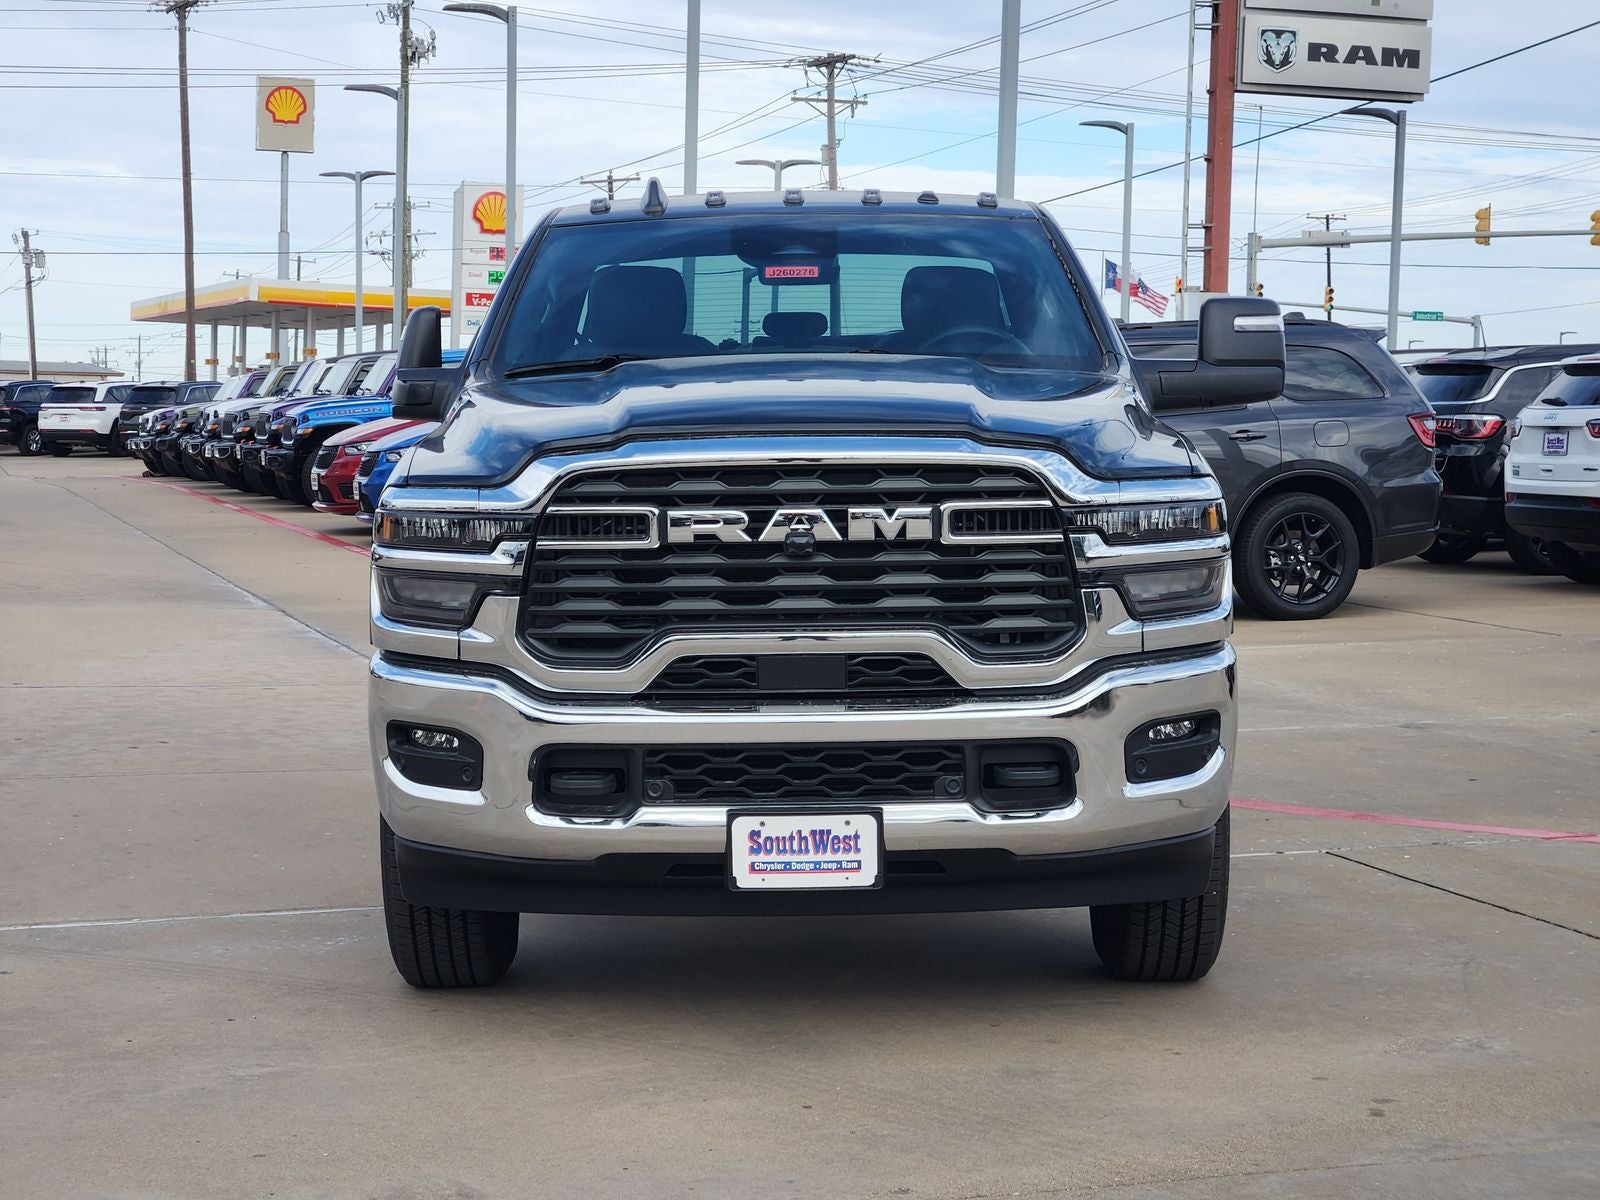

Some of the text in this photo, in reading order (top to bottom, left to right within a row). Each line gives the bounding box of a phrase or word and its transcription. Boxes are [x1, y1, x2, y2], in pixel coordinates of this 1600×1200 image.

[1307, 42, 1420, 69] RAM
[769, 268, 815, 277] J260276
[316, 407, 382, 417] RUBICON
[666, 507, 933, 543] RAM
[754, 861, 858, 871] Chrysler Dodge Jeep Ram
